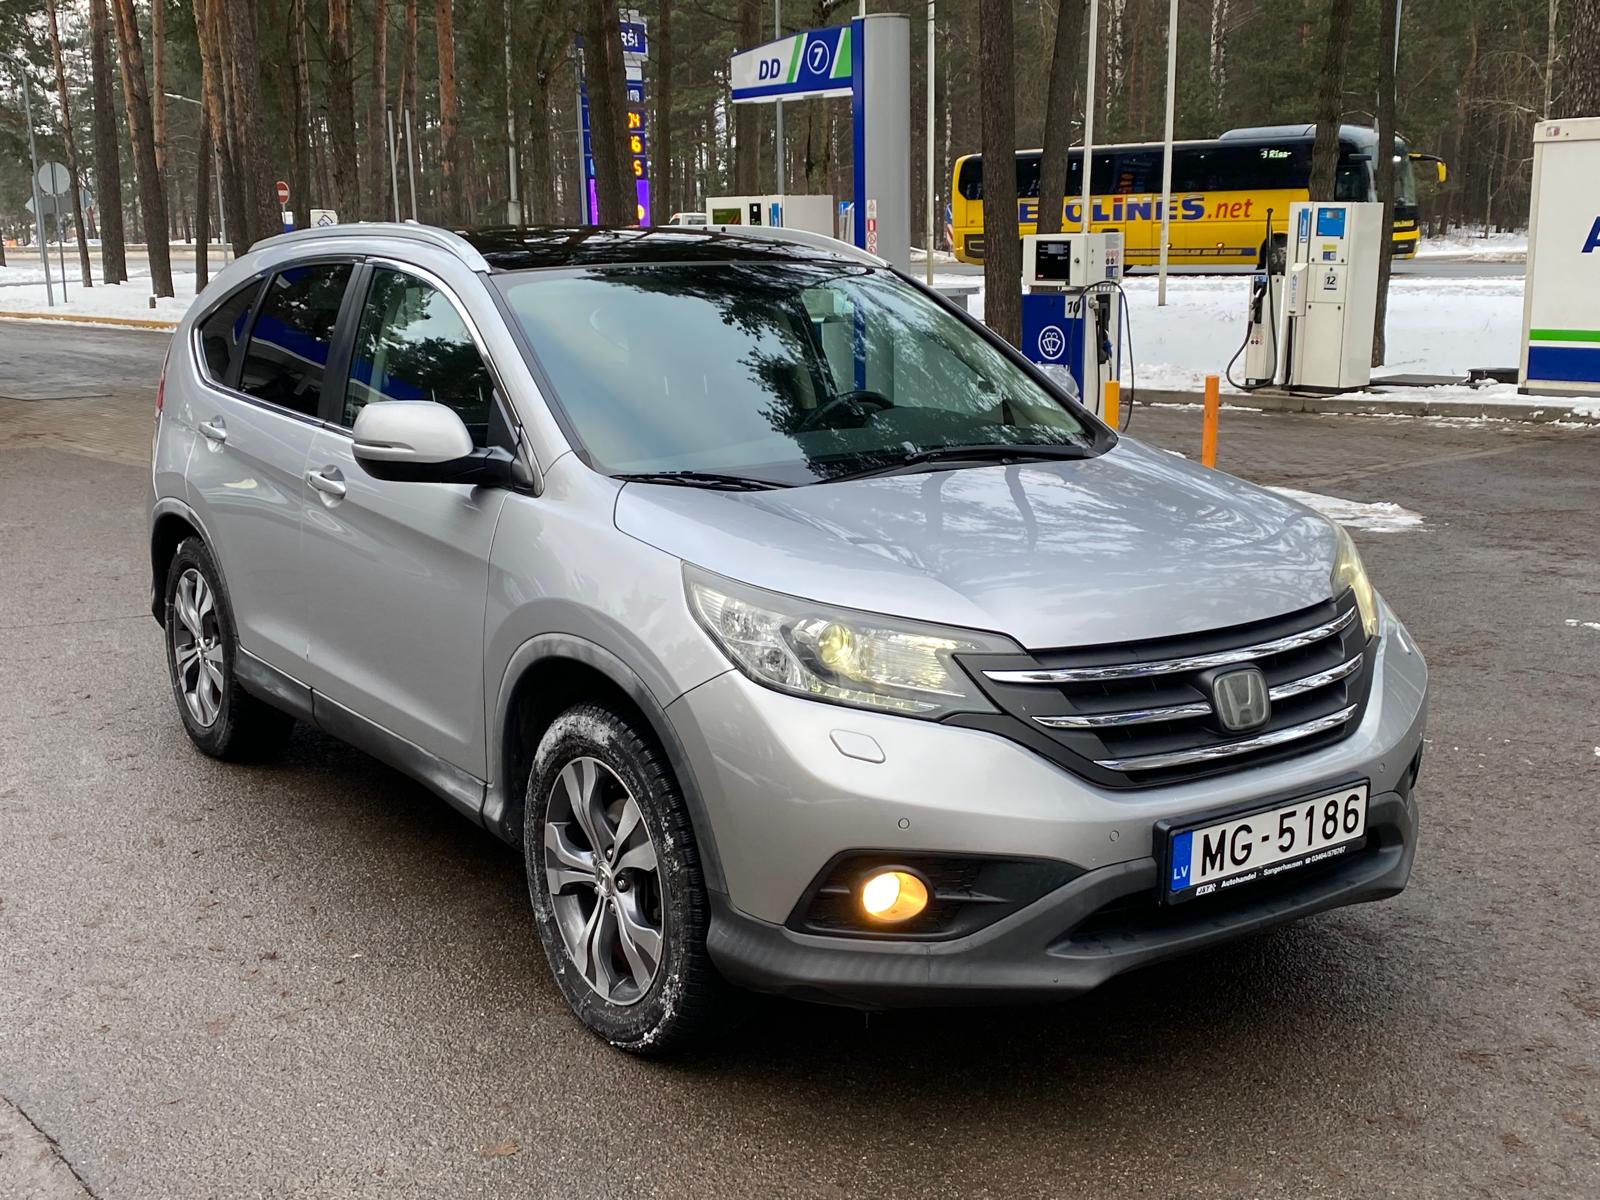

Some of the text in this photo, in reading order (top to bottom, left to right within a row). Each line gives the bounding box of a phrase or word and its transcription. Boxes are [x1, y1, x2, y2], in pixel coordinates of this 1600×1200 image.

[759, 47, 823, 80] DD 7
[1326, 276, 1336, 285] 12
[1067, 301, 1080, 314] 10
[1201, 794, 1360, 876] MG-5186
[1173, 865, 1189, 880] LV
